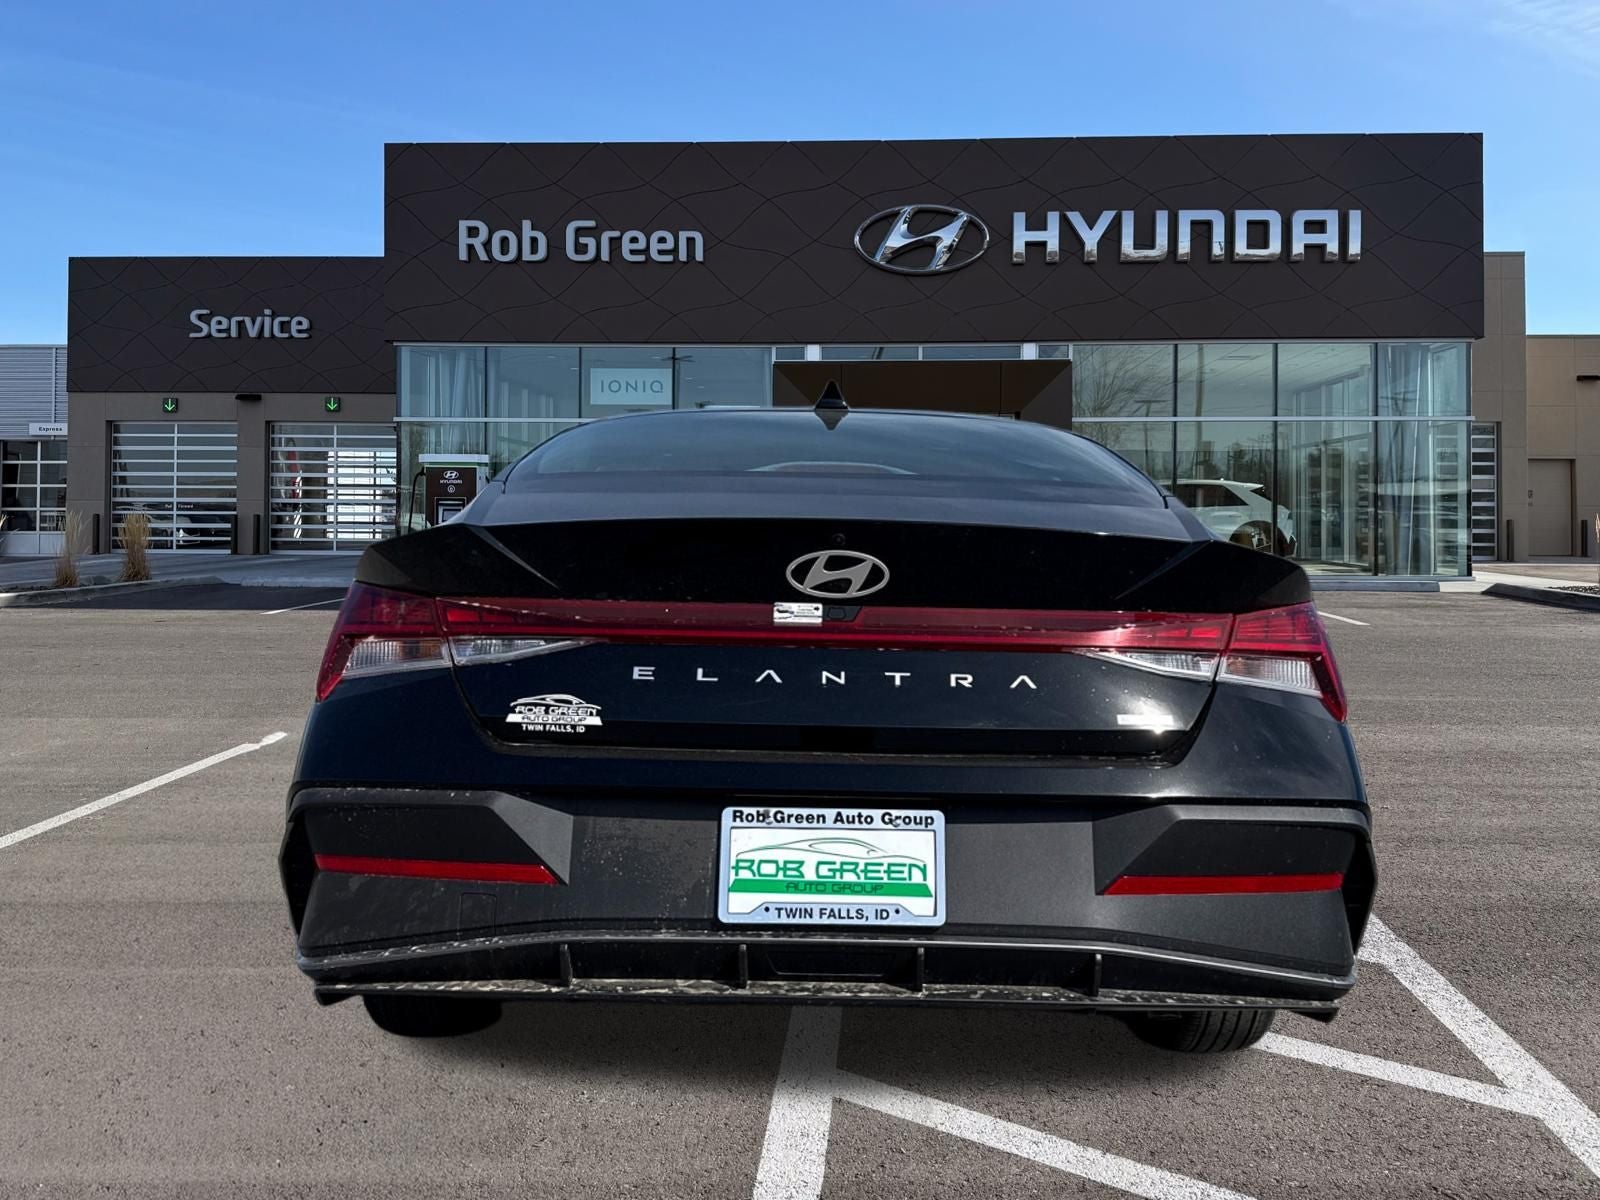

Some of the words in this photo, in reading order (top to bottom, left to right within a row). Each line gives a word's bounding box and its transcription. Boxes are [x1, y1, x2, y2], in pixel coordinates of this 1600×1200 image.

[458, 219, 549, 263] Rob
[565, 219, 705, 263] Green
[1011, 209, 1362, 264] HYUNDAI
[188, 308, 312, 340] Service
[600, 379, 664, 394] IONIQ
[632, 665, 1037, 689] ELANTRA
[514, 705, 546, 715] ROB
[548, 706, 597, 717] GREEN
[521, 723, 544, 731] TWIN
[545, 724, 575, 733] FALLS,
[575, 725, 586, 733] ID
[732, 809, 766, 824] Rob
[772, 810, 827, 825] Green
[832, 811, 875, 826] Auto
[880, 811, 935, 828] Group
[731, 858, 806, 880] ROB
[814, 860, 928, 882] GREEN
[785, 881, 828, 894] AUTO
[831, 882, 885, 895] GROUP
[774, 907, 817, 921] TWIN
[818, 907, 870, 922] FALLS,
[874, 908, 890, 921] ID
